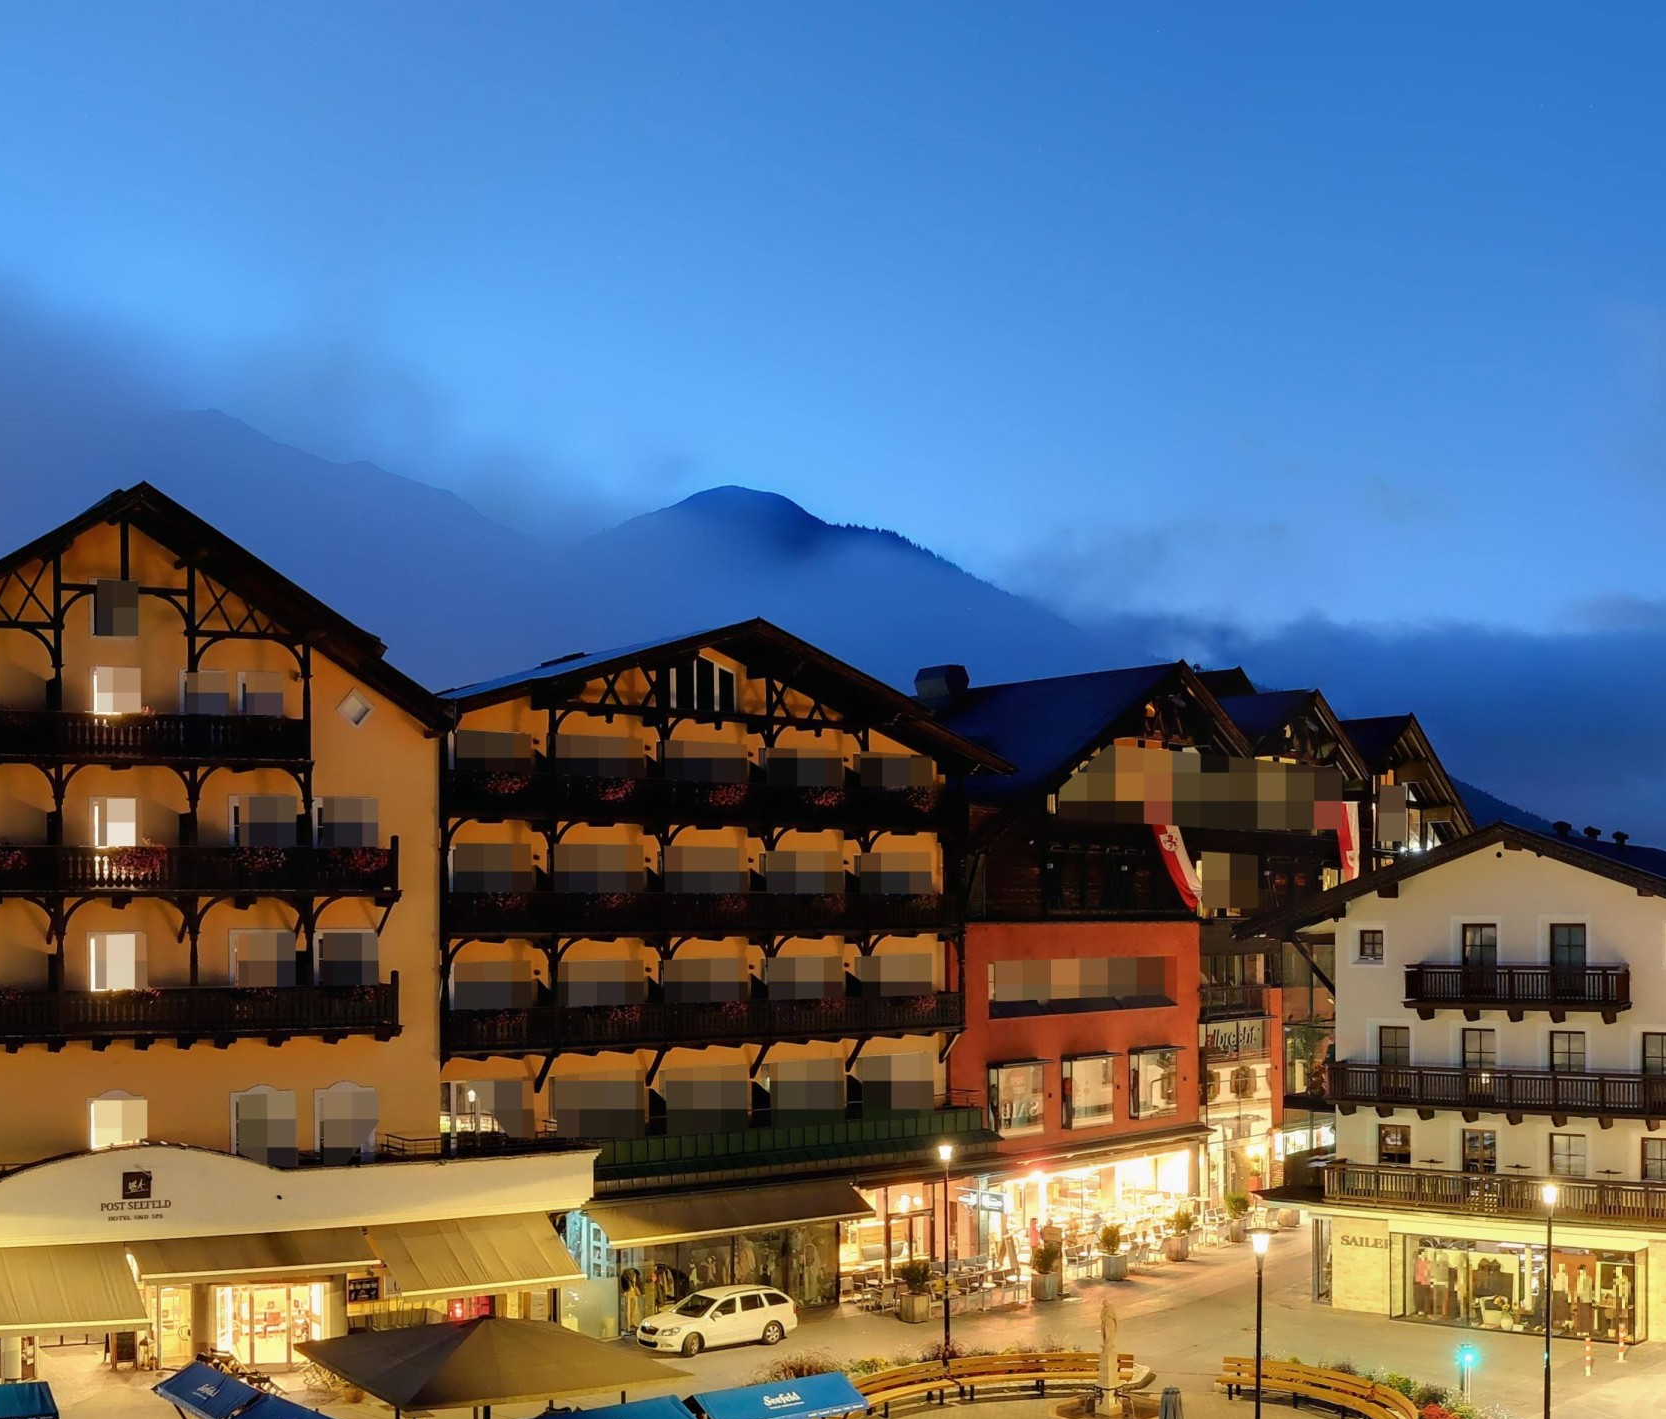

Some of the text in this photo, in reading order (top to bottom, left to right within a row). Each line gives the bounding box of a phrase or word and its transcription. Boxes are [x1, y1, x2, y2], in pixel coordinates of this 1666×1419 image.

[100, 1199, 172, 1212] POST SEEFELD
[762, 1391, 801, 1407] Seefeld
